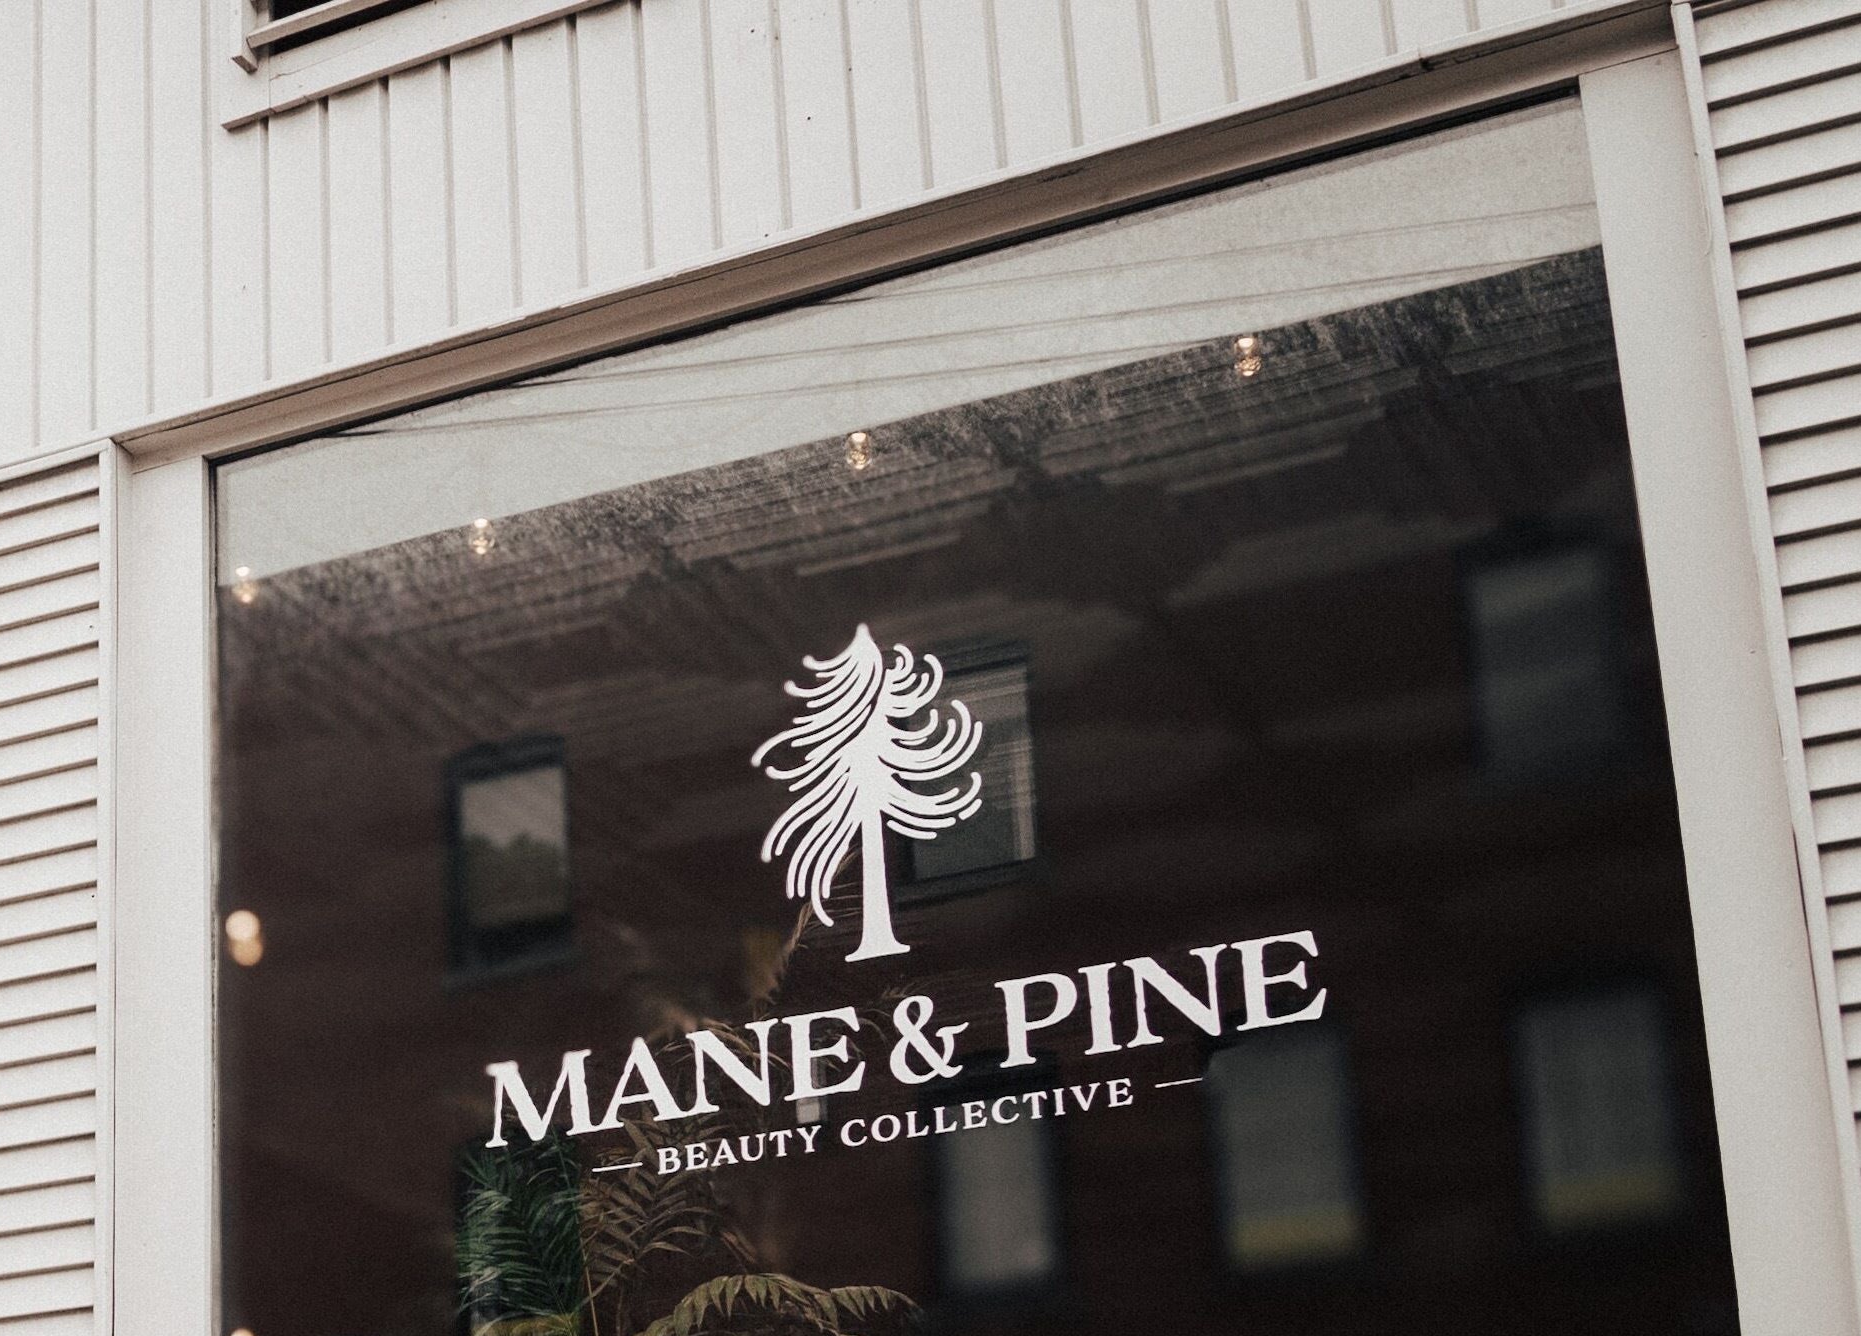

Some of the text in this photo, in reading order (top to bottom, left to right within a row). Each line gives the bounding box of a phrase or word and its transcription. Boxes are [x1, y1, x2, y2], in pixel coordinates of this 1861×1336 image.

[485, 930, 1327, 1148] MANE & PINE
[656, 1077, 1134, 1175] BEAUTY COLLECTIVE
